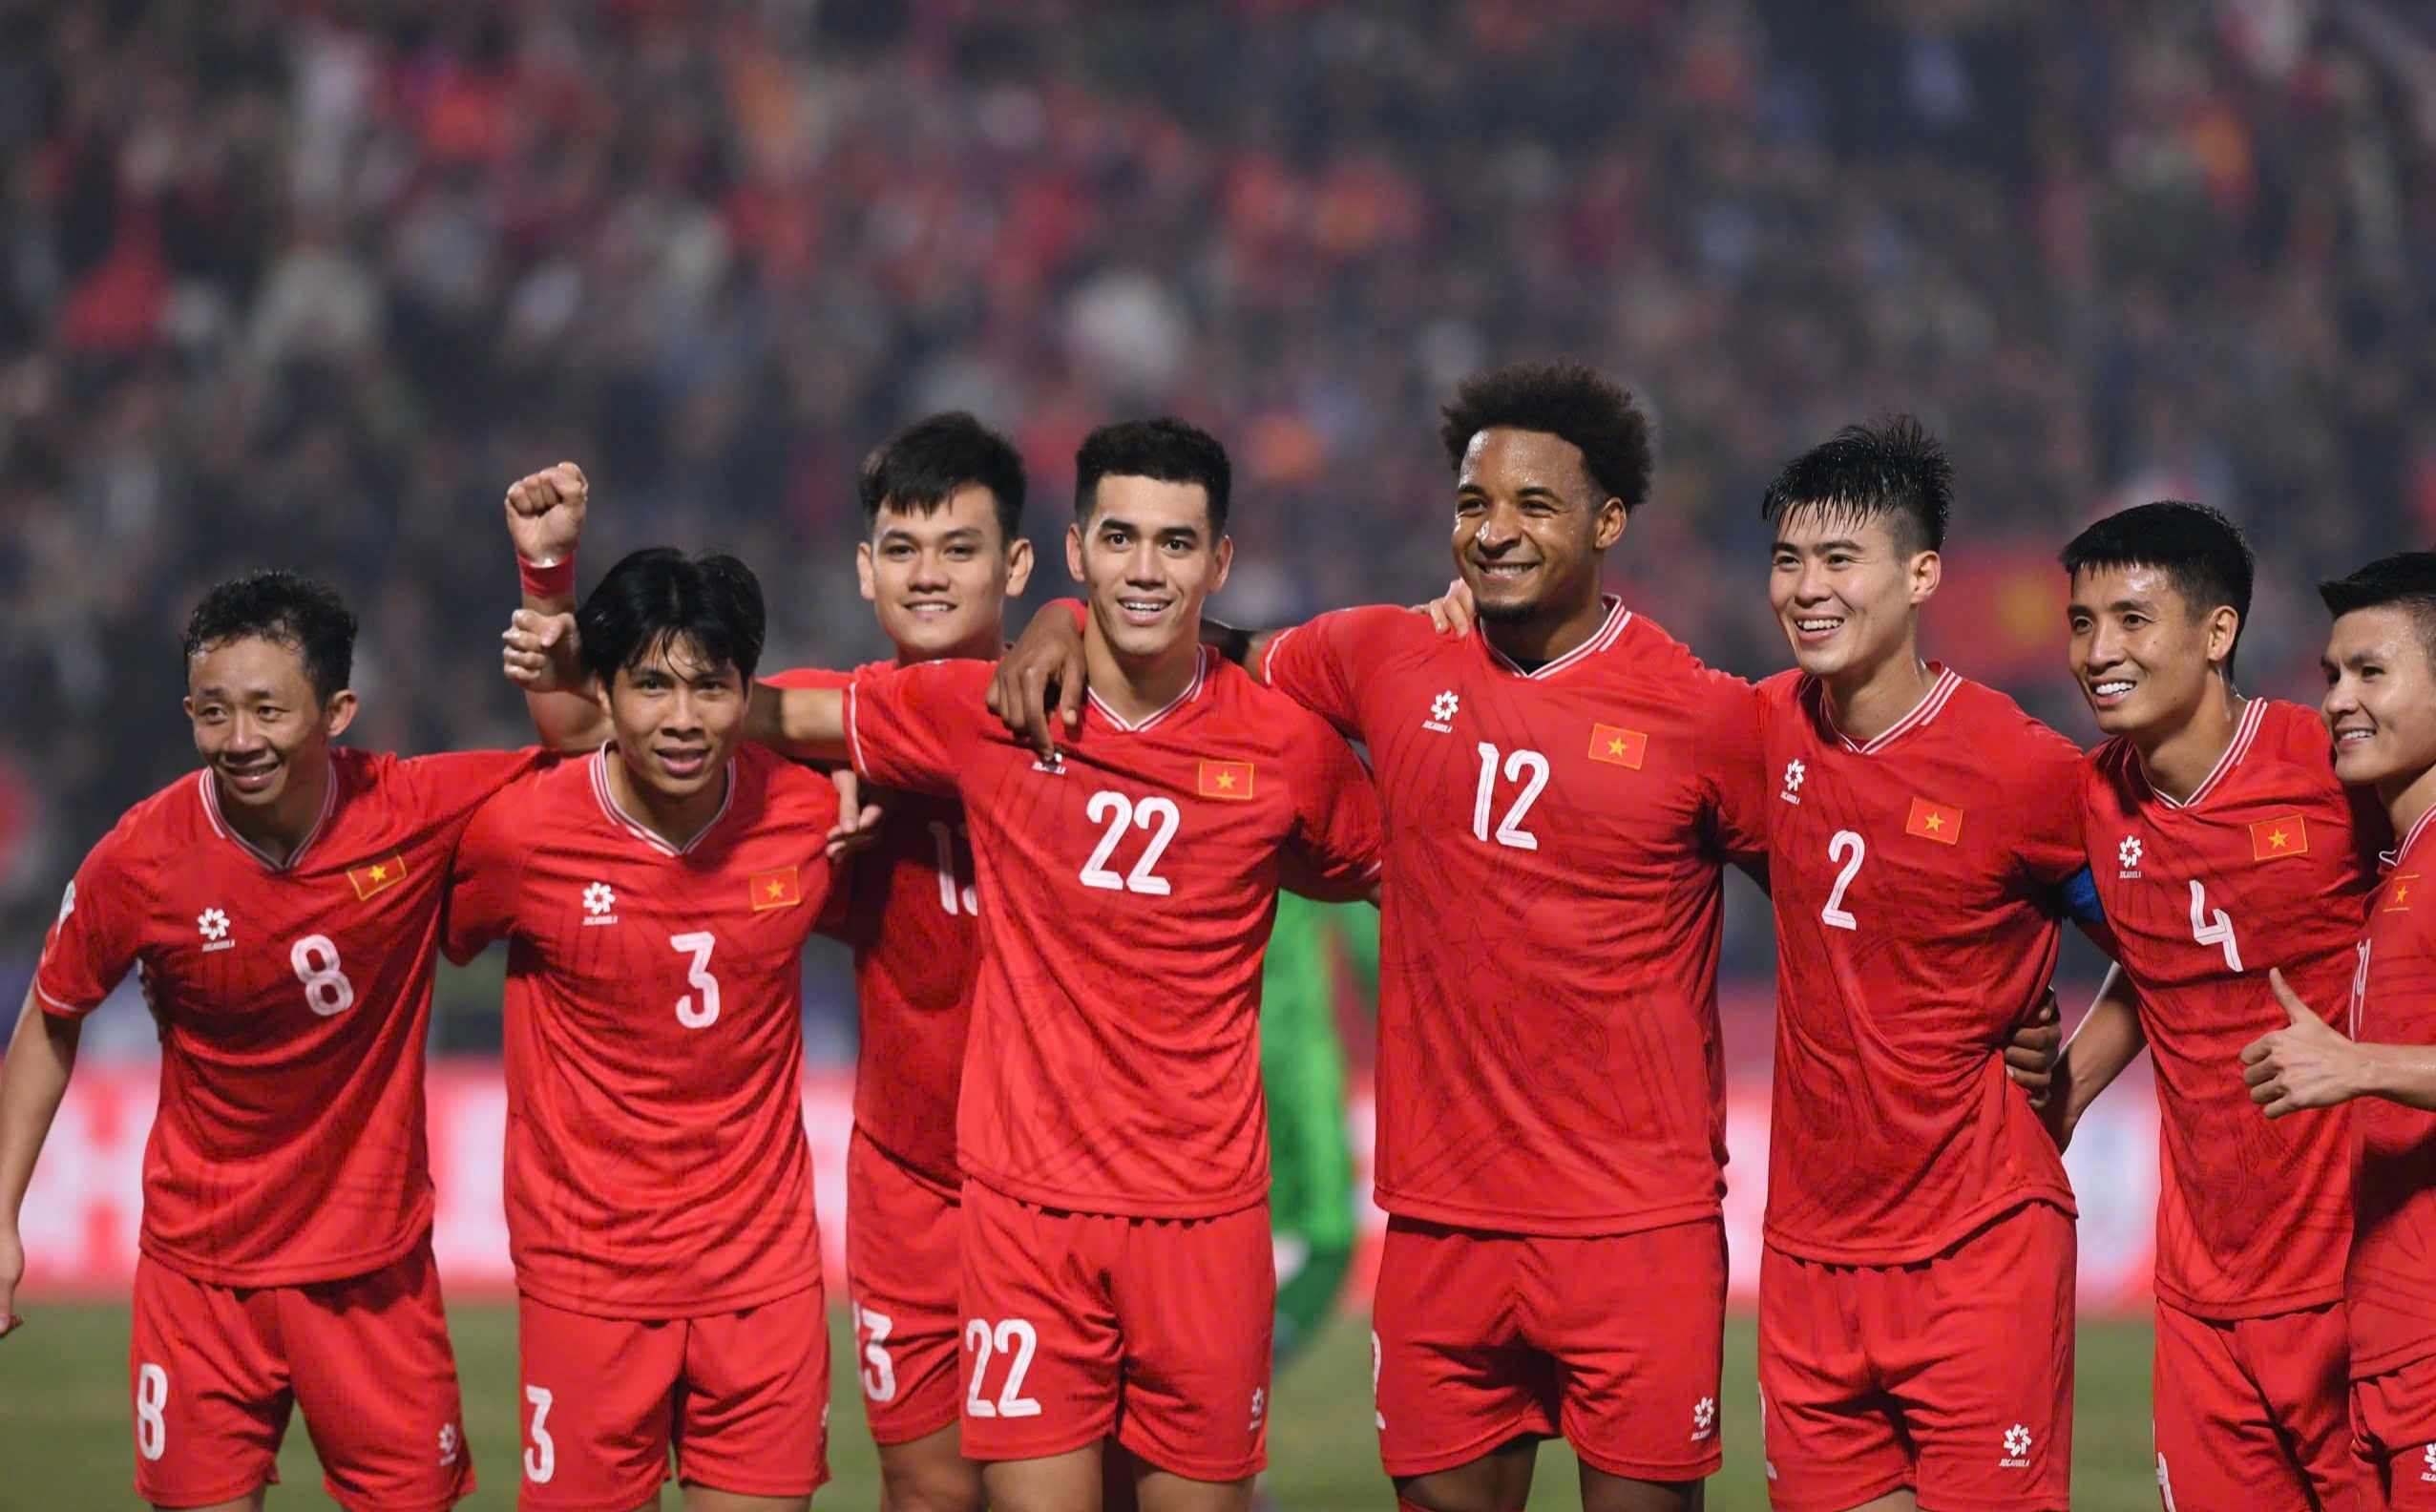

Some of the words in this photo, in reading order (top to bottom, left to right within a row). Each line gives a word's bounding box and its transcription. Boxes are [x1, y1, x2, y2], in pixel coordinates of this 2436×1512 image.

[1079, 790, 1180, 895] 22
[1474, 742, 1550, 850] 12
[1821, 830, 1866, 931] 2
[2189, 879, 2244, 972] 4
[290, 934, 355, 1017] 8
[670, 931, 720, 1029] 3
[137, 1362, 168, 1460] 8
[966, 1318, 1041, 1418] 22
[524, 1384, 556, 1483] 3
